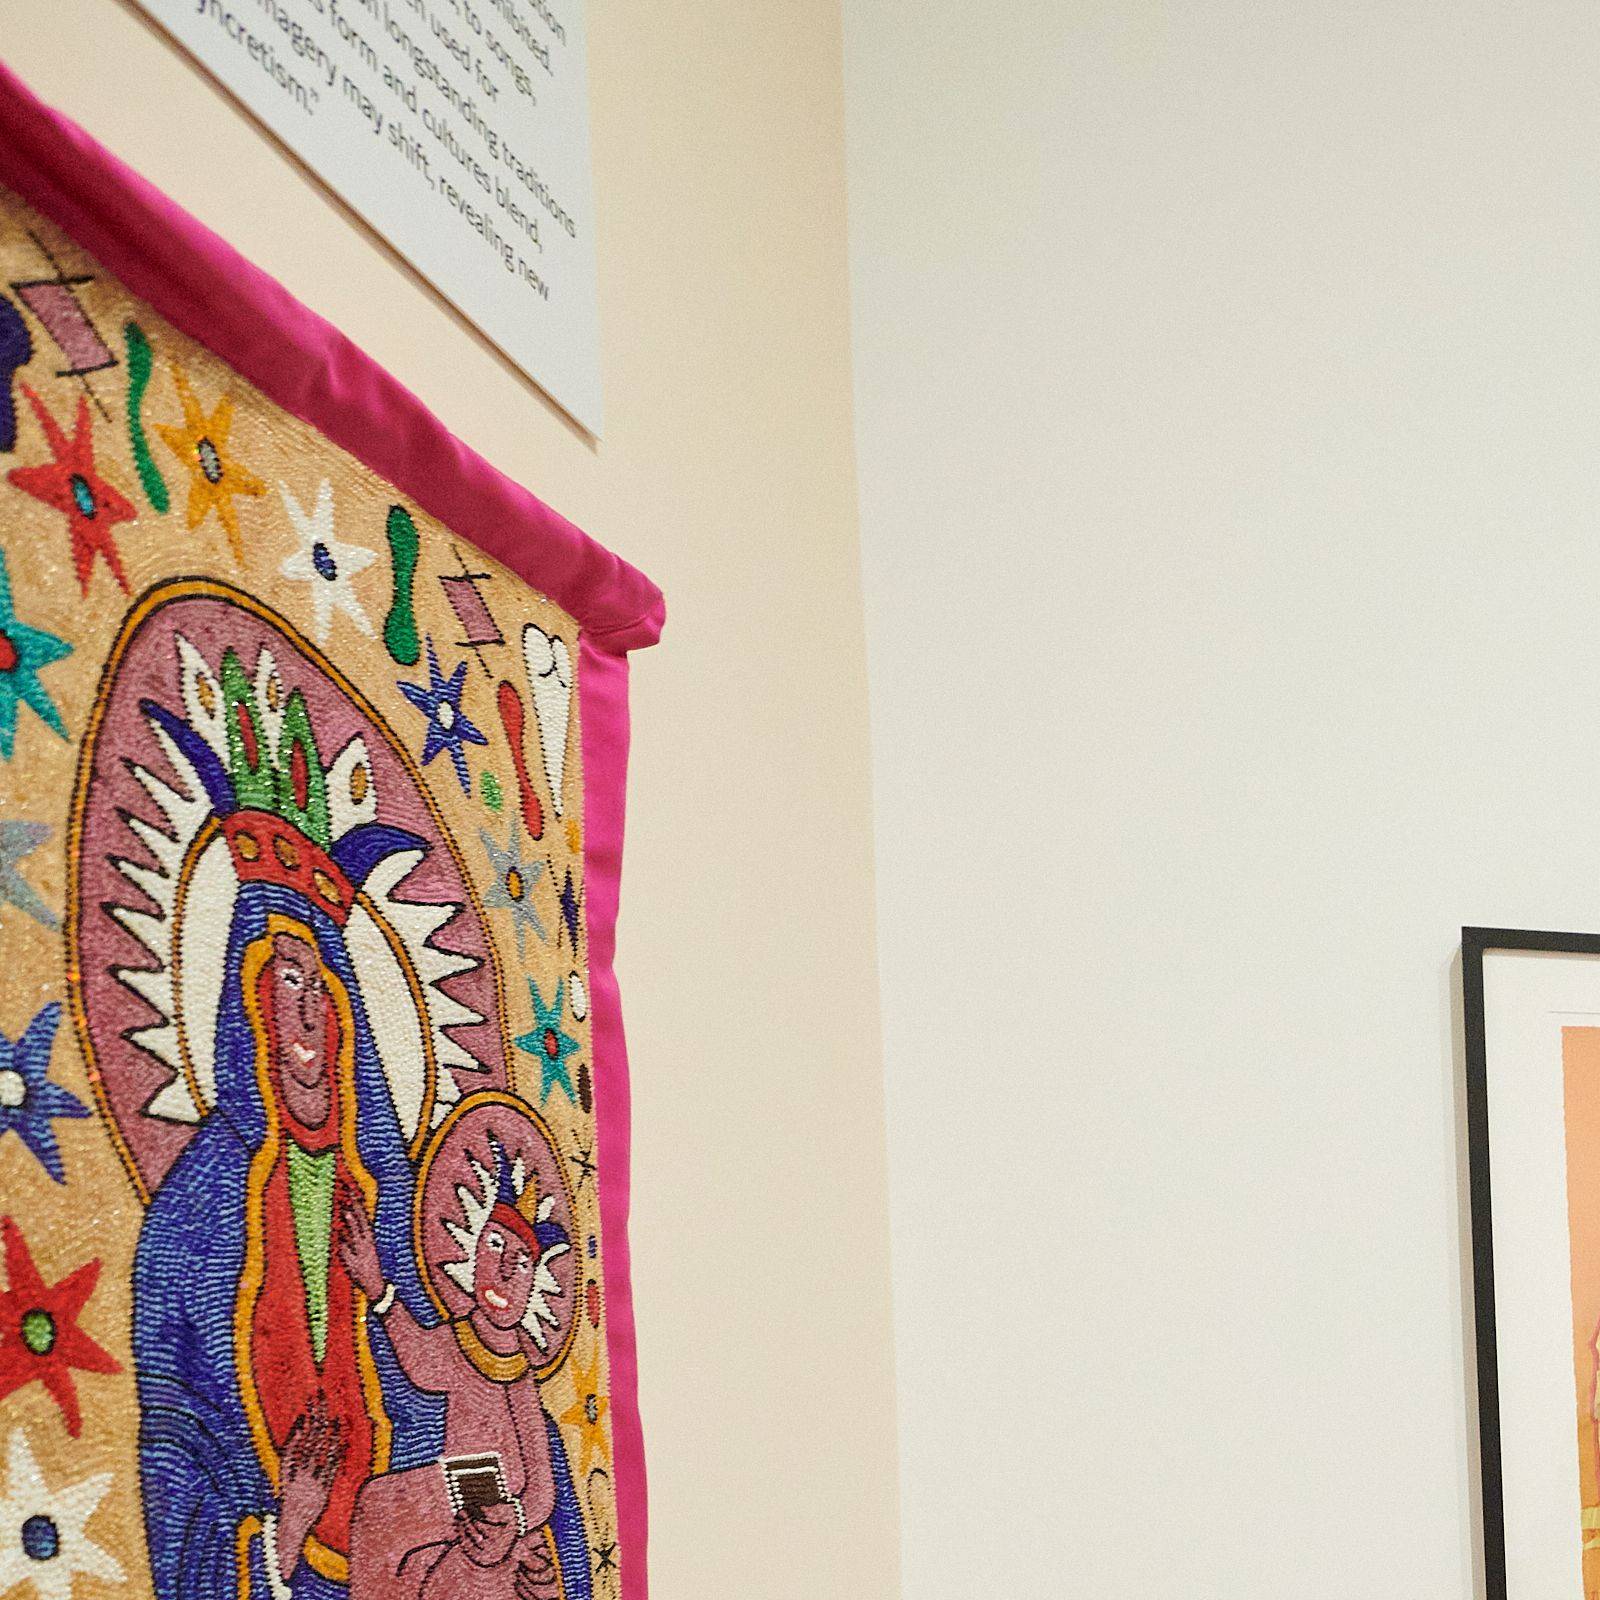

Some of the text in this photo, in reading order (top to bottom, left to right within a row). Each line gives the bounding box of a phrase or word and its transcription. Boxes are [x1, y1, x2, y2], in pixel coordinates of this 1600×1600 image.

[329, 0, 378, 71] form
[382, 64, 418, 115] and
[422, 107, 491, 194] cultures
[495, 175, 543, 254] blend,
[383, 0, 576, 239] longstanding traditions
[431, 13, 470, 72] used
[475, 58, 499, 102] for
[464, 0, 537, 106] to songs,
[343, 75, 383, 135] may
[388, 121, 435, 190] shift,
[439, 175, 515, 274] revealing
[518, 257, 549, 302] new
